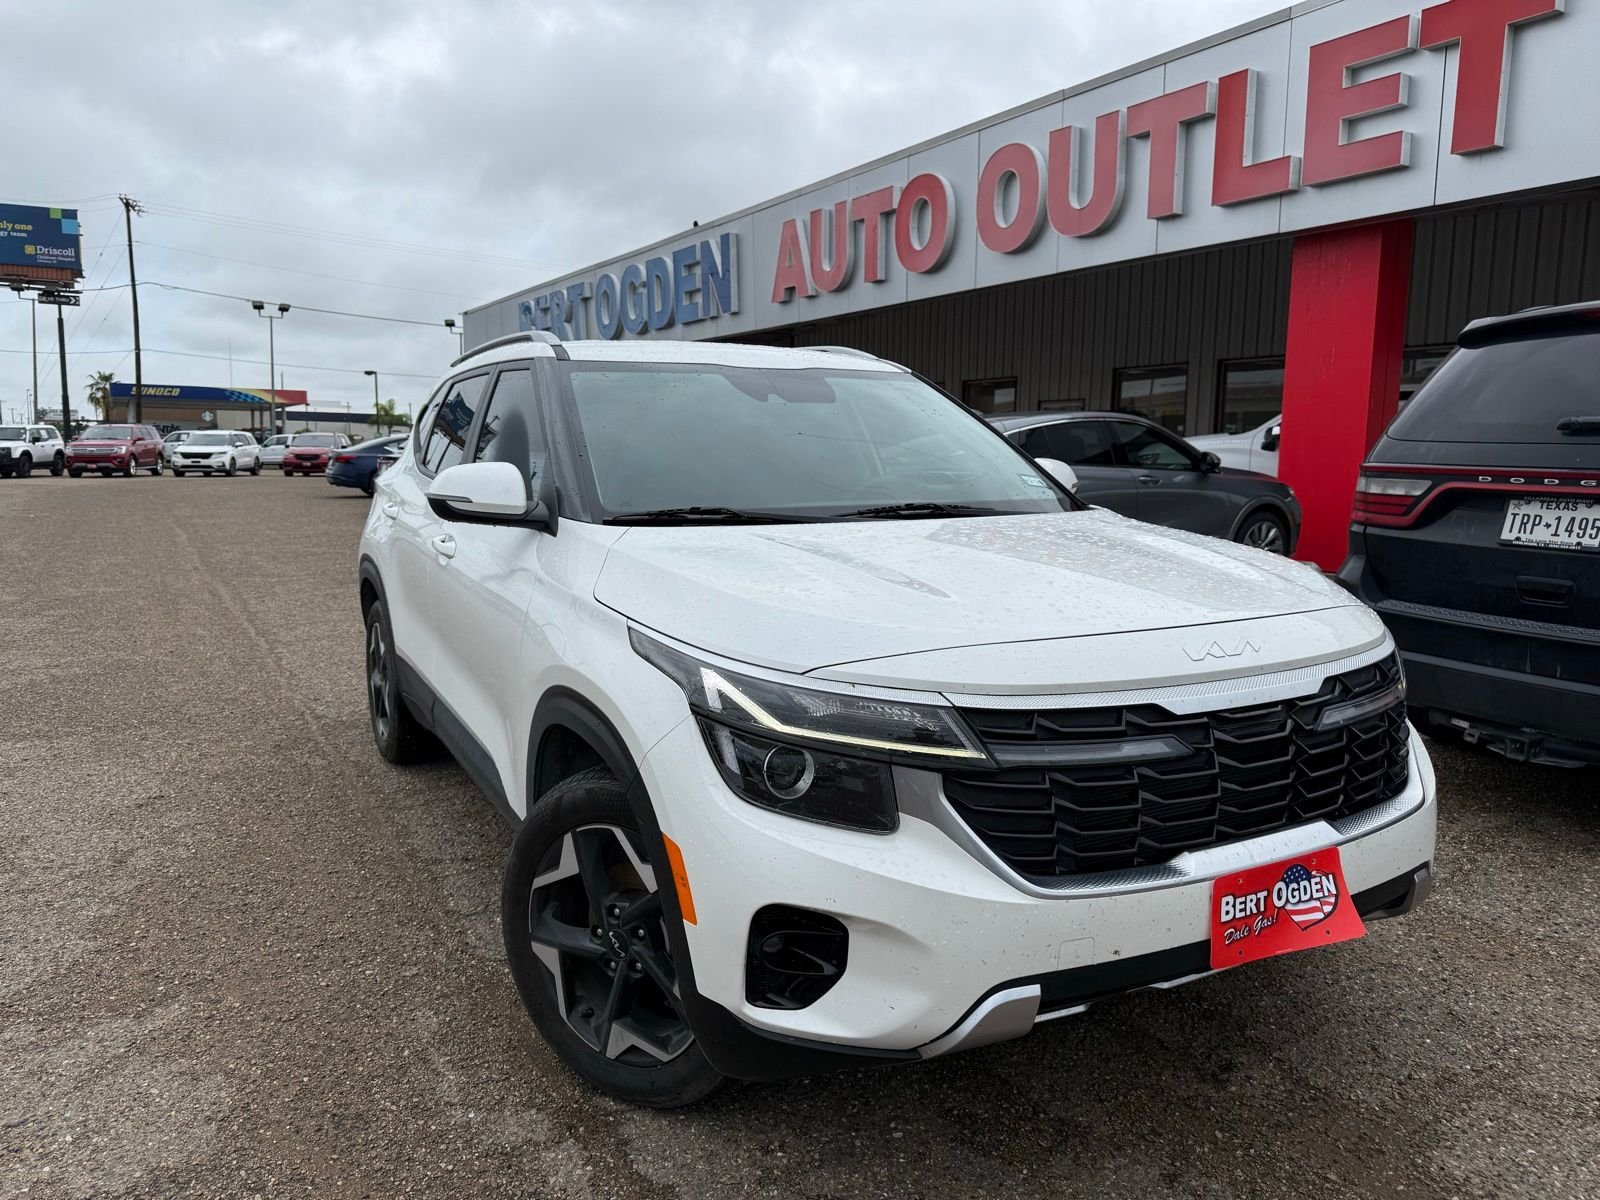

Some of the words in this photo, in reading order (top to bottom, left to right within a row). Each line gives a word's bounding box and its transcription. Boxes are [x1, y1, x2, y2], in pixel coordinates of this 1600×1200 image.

[518, 281, 592, 341] BERT
[595, 232, 738, 340] OGDEN
[771, 172, 955, 303] AUTO
[976, 0, 1564, 253] OUTLET
[14, 223, 32, 231] one
[36, 245, 75, 256] Driscoll
[131, 386, 180, 396] SUNOCO
[1540, 501, 1579, 511] TEXAS
[1220, 890, 1268, 923] BERT
[1272, 874, 1337, 908] OGDEN
[1224, 923, 1250, 945] Dale
[1253, 908, 1278, 936] Gas!
